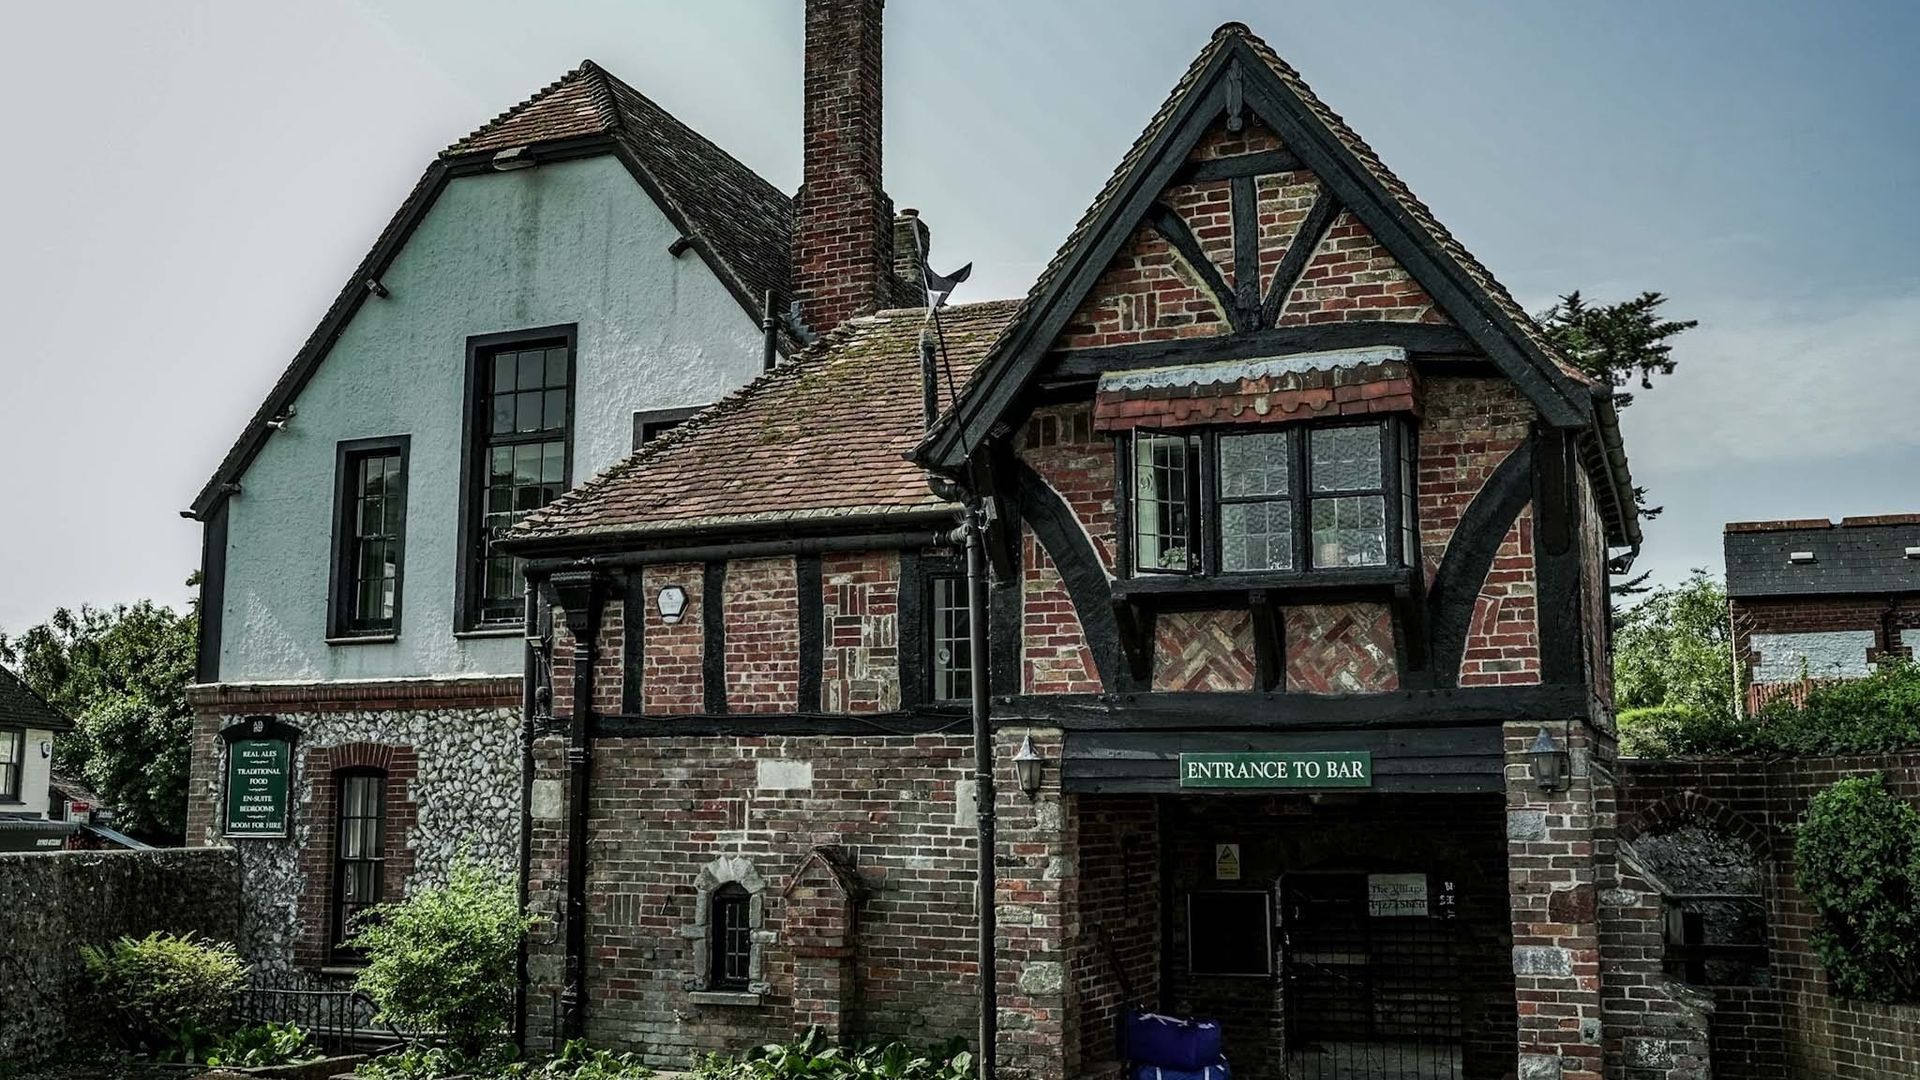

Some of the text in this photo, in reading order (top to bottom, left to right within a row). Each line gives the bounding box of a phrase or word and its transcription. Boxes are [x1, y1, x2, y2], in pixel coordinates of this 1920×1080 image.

[242, 750, 278, 758] REAL ALES
[1187, 760, 1365, 779] ENTRANCE TO BAR
[249, 777, 269, 785] FOOD
